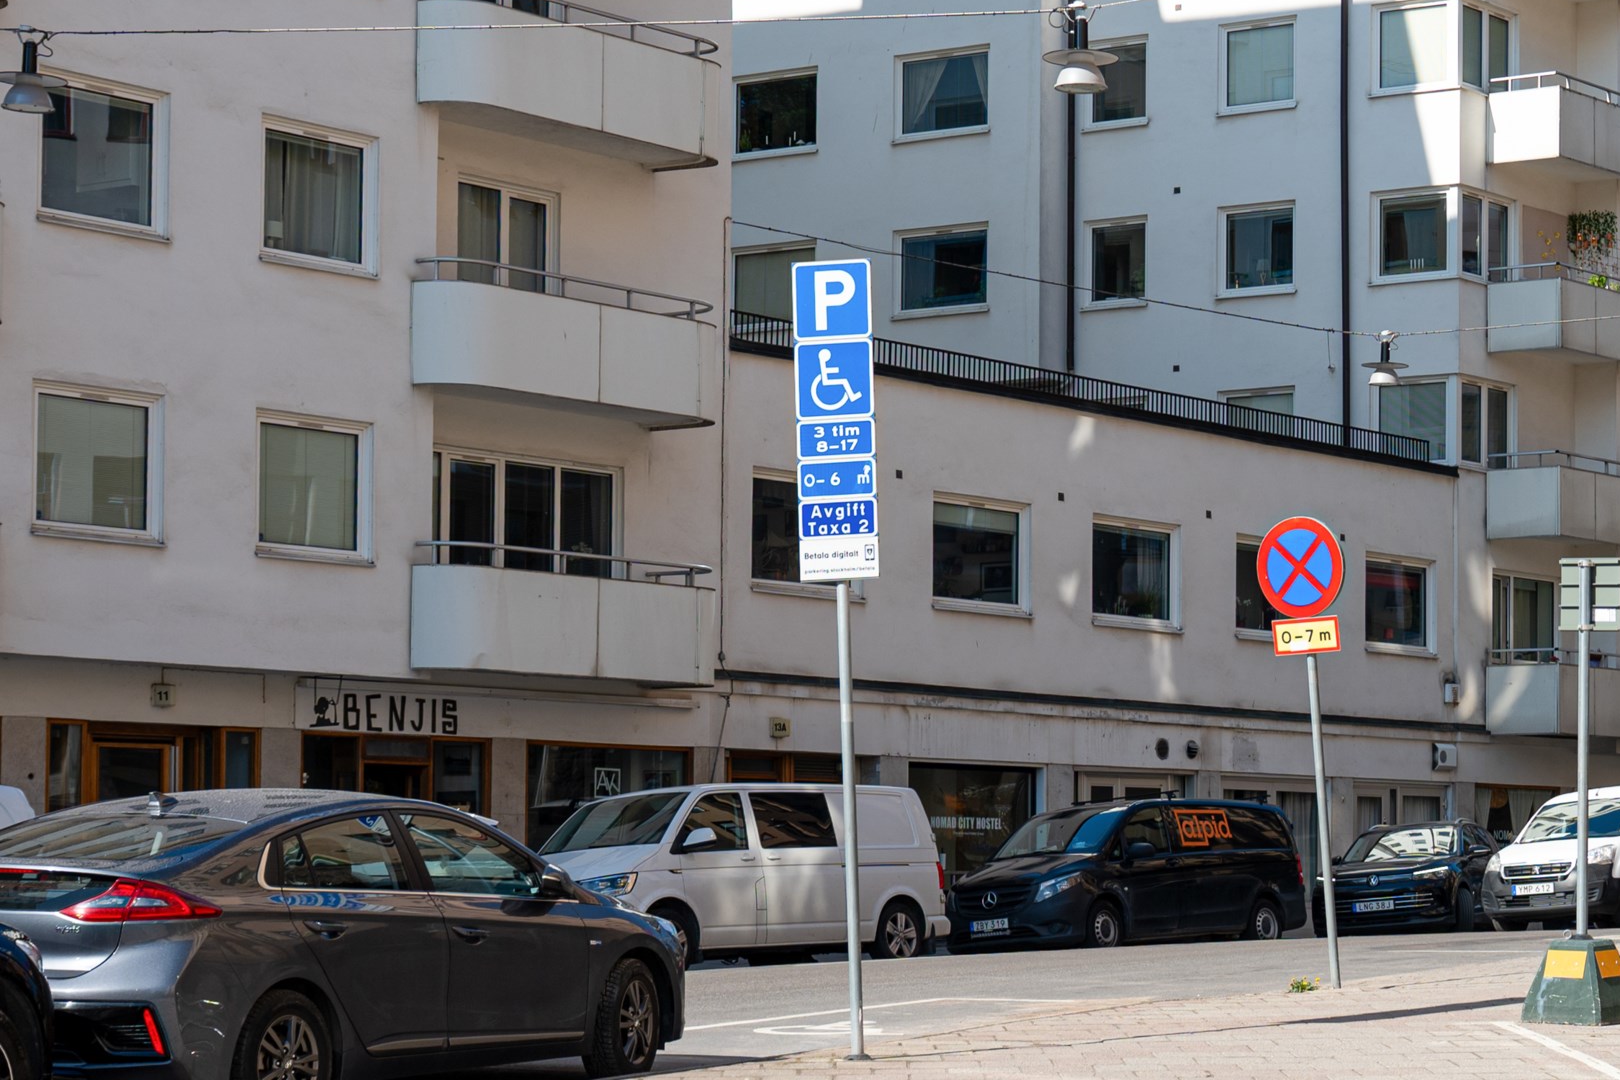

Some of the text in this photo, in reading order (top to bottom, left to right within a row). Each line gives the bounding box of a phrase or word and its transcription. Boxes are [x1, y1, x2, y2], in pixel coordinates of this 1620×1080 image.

[814, 270, 856, 331] P
[814, 425, 860, 438] 3 tim
[816, 439, 858, 452] 8-17
[857, 473, 870, 484] m
[811, 503, 865, 520] Avgift
[808, 519, 869, 535] Taxa 2
[804, 550, 859, 560] Betala digitalt
[1319, 630, 1331, 641] m
[157, 691, 168, 701] 11
[343, 693, 458, 735] BENJIS
[774, 722, 787, 731] 13A
[930, 816, 1002, 830] NOMAD CITY HOSTEL
[1182, 815, 1233, 845] alpid
[1518, 885, 1533, 893] YMP
